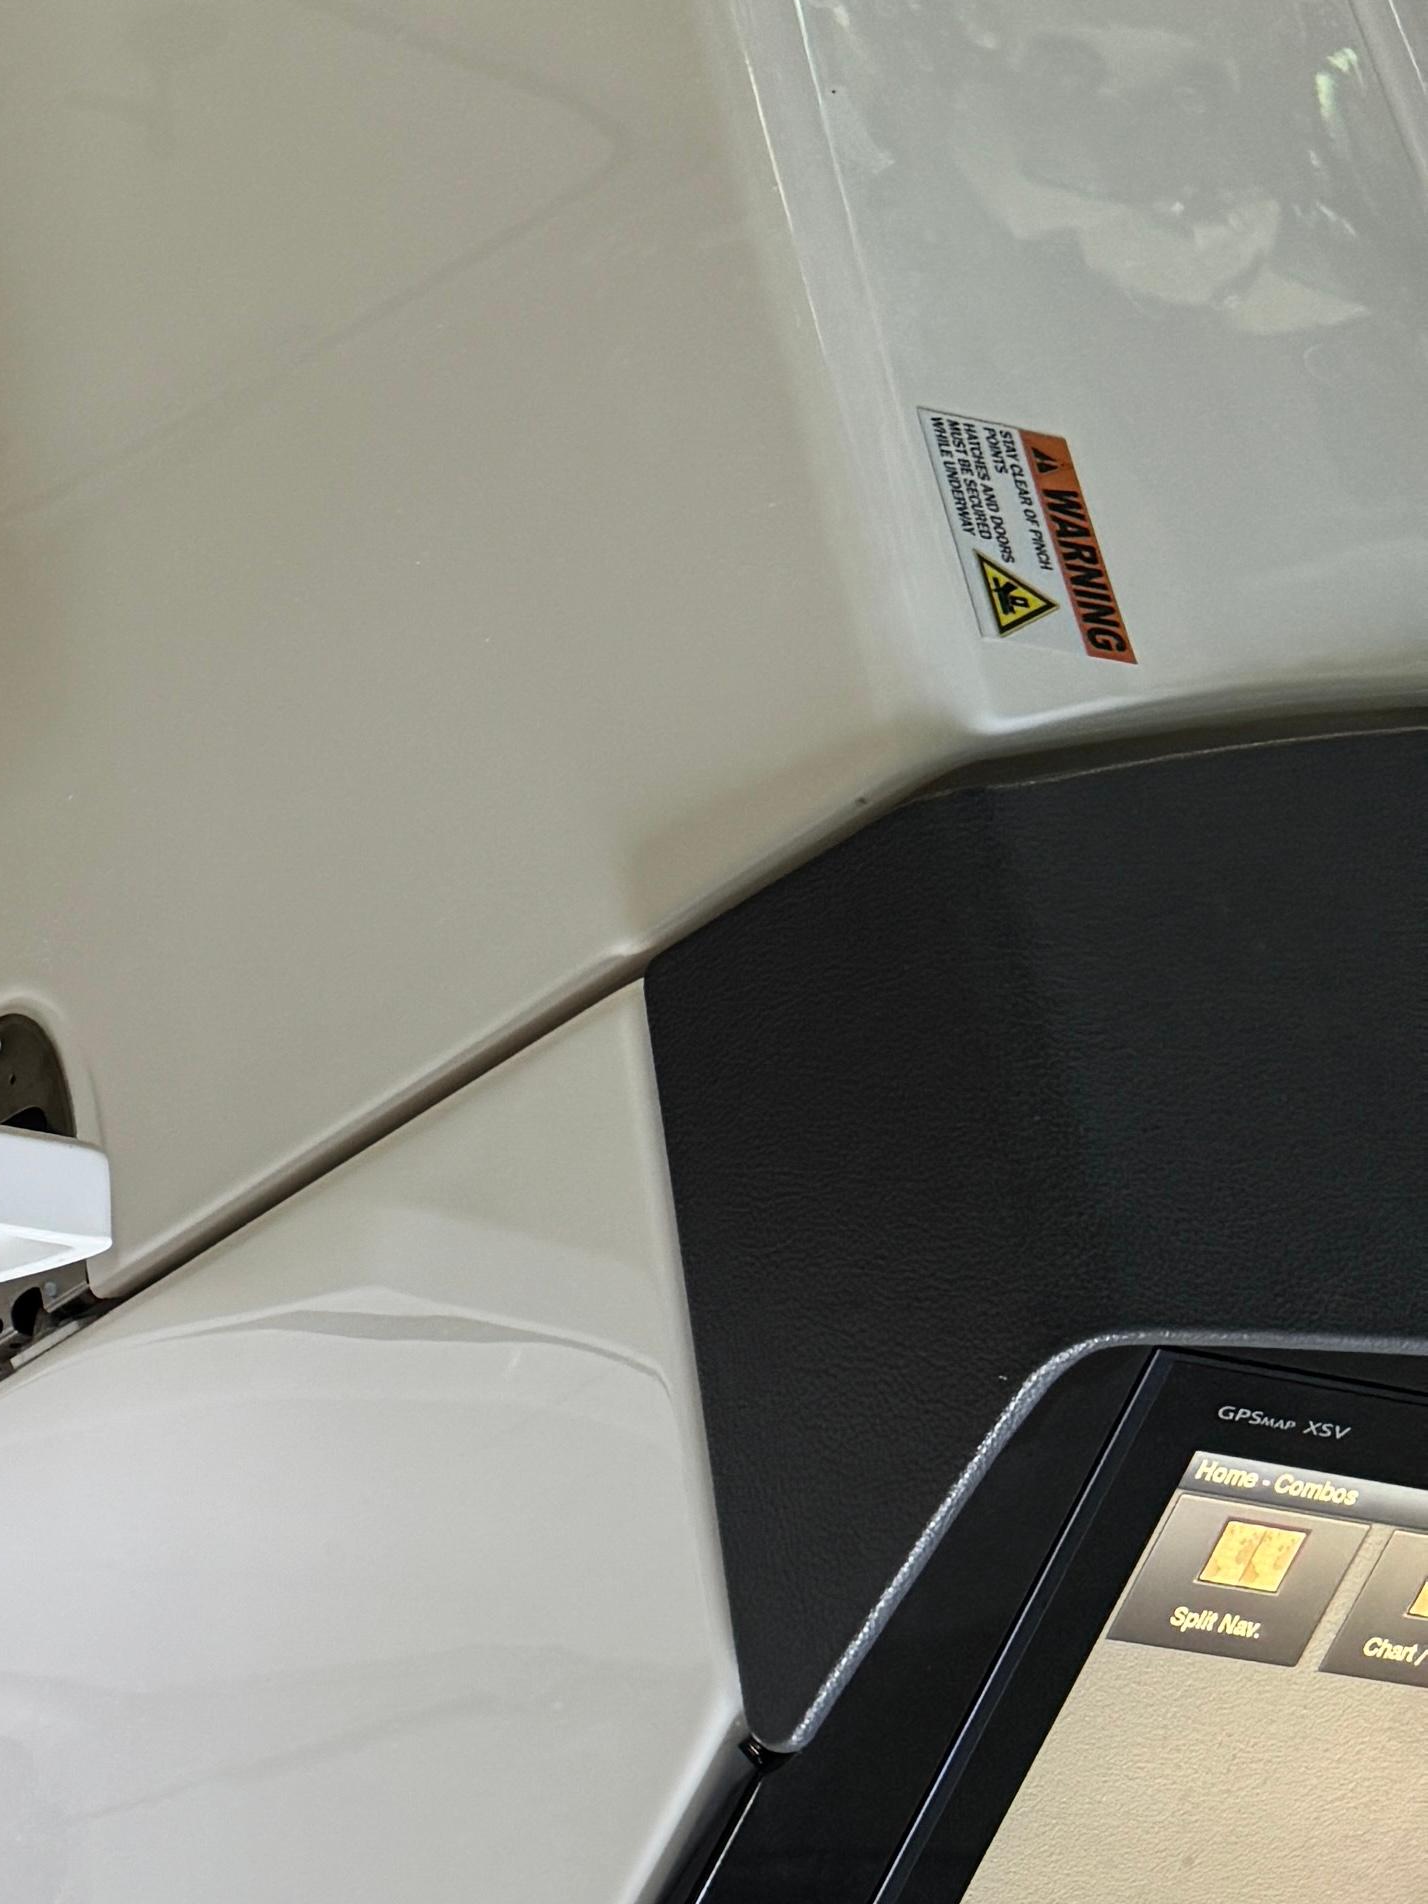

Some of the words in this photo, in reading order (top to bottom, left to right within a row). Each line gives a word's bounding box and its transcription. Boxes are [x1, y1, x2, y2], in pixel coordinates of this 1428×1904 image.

[946, 419, 968, 456] MUST
[983, 427, 1008, 474] POINTS
[1000, 430, 1020, 462] STAY
[930, 417, 953, 458] WHILE
[943, 461, 976, 536] UNDERWAY
[958, 458, 974, 476] BE
[1010, 464, 1033, 506] CLEAR
[963, 423, 991, 481] HATCHES
[980, 483, 999, 512] AND
[990, 516, 1015, 563] DOORS
[964, 478, 992, 539] SECURED
[1024, 509, 1040, 527] OF
[1029, 529, 1054, 571] PINCH
[1042, 489, 1127, 654] WARNING
[1302, 1420, 1352, 1440] XSV
[1194, 1459, 1259, 1489] Home
[1274, 1473, 1360, 1506] Combos
[1170, 1606, 1218, 1633] Split
[1218, 1613, 1261, 1639] Nav.
[1363, 1637, 1418, 1663] Chart
